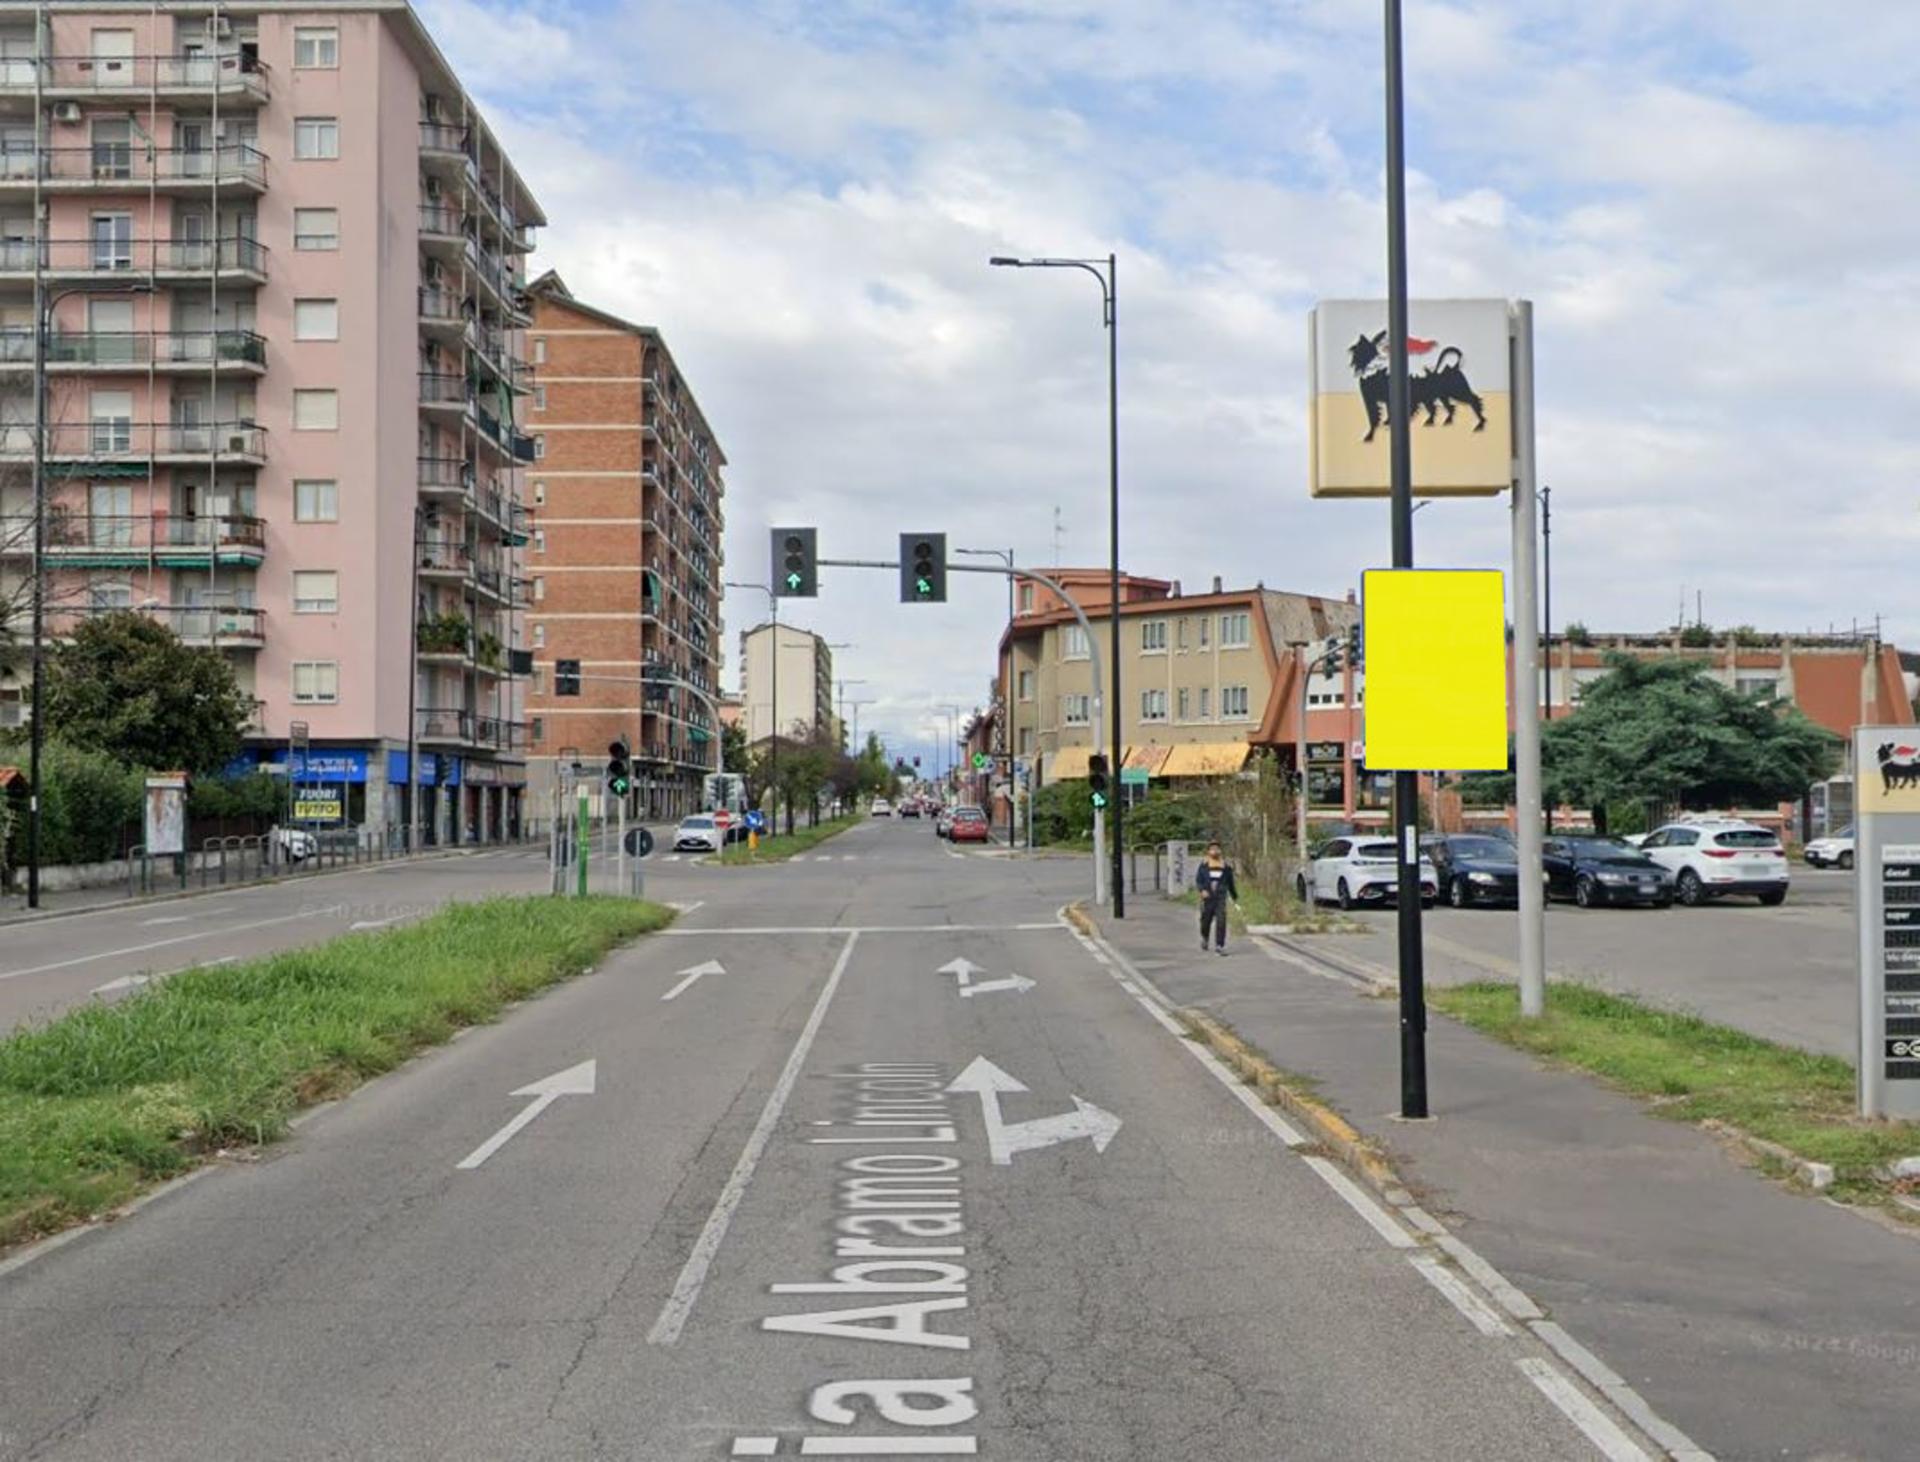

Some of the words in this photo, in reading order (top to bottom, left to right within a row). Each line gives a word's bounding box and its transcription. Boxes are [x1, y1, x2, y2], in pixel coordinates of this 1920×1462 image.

[298, 788, 337, 800] FUORI
[808, 1062, 957, 1143] Lincoln
[761, 1153, 970, 1350] Abramo
[730, 1377, 979, 1456] ia
